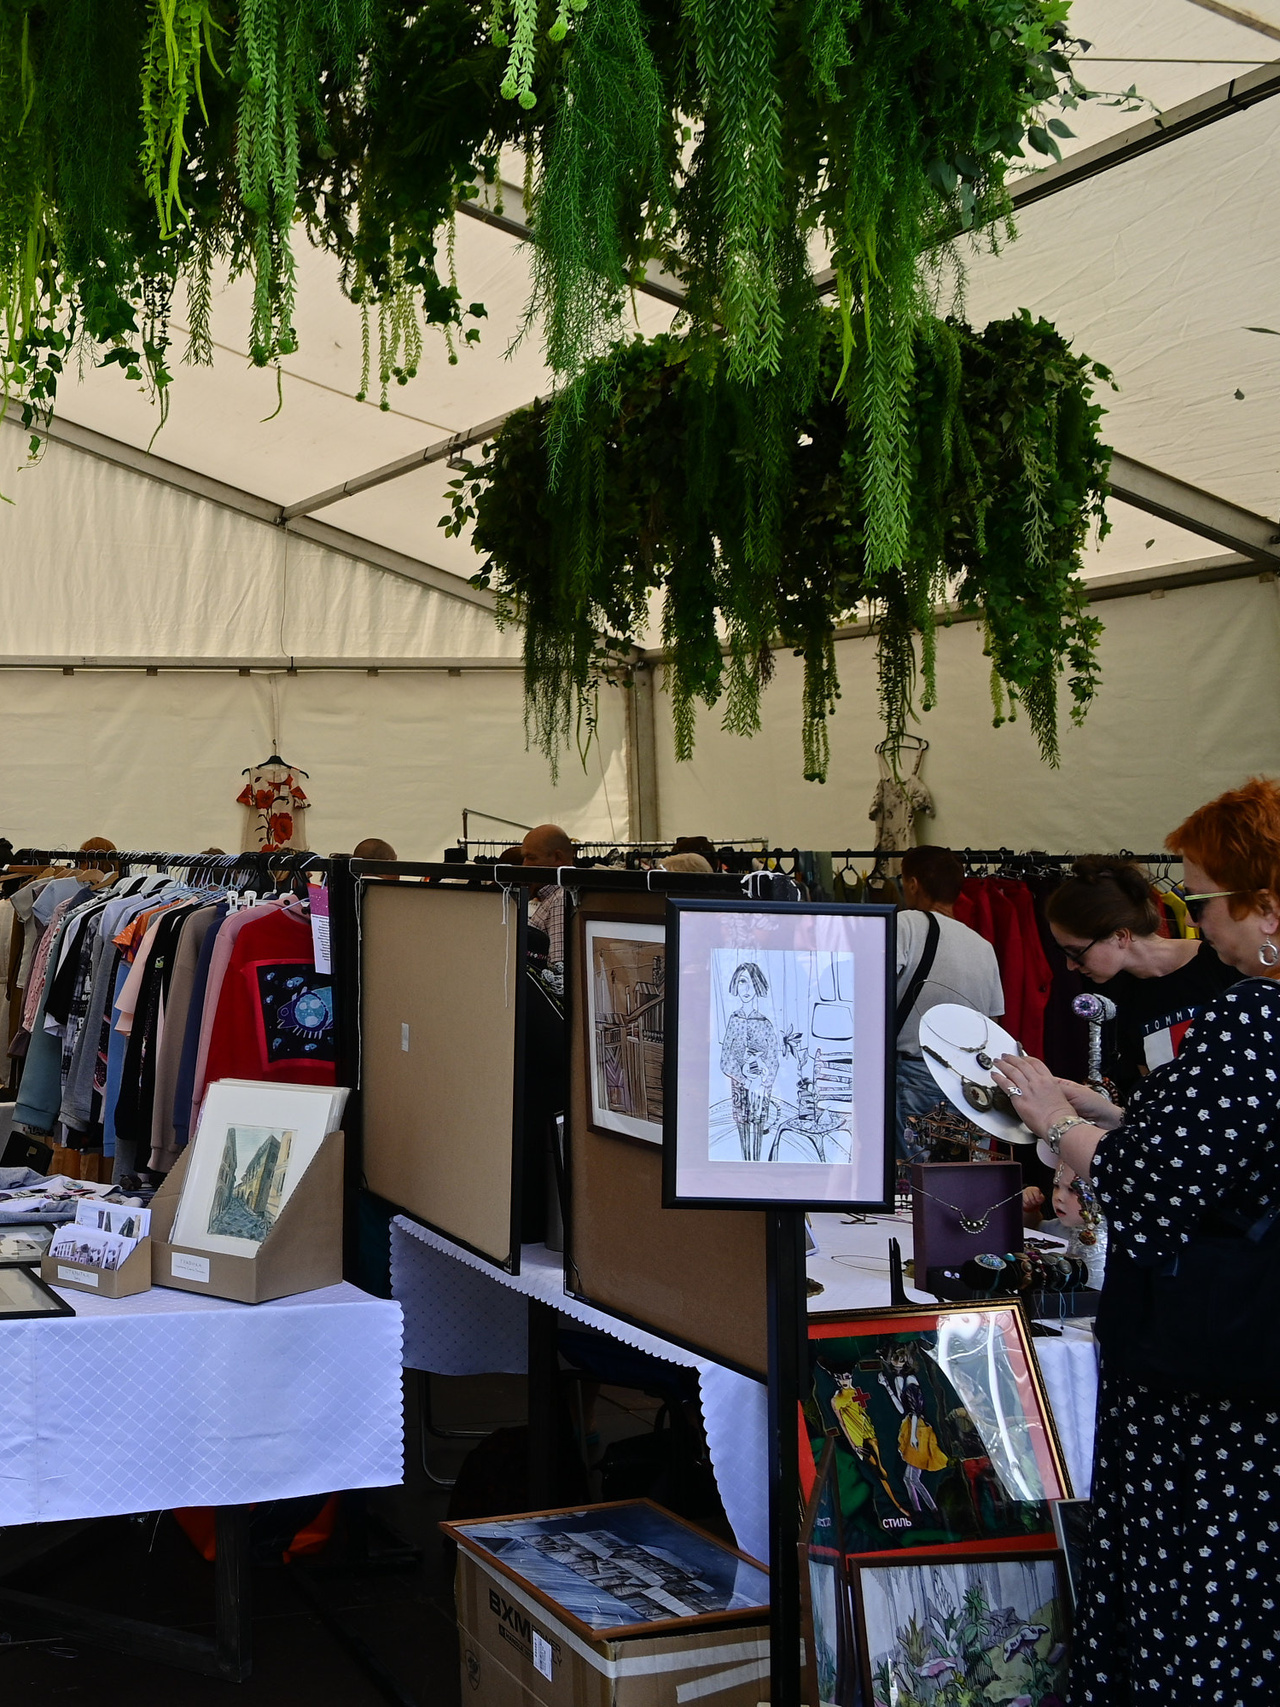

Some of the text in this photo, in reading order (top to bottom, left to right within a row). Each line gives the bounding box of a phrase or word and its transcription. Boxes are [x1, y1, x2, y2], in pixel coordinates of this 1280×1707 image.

[1144, 1007, 1195, 1034] TOMMY
[882, 1517, 913, 1529] СТИЛЬ
[490, 1588, 532, 1645] BXM
